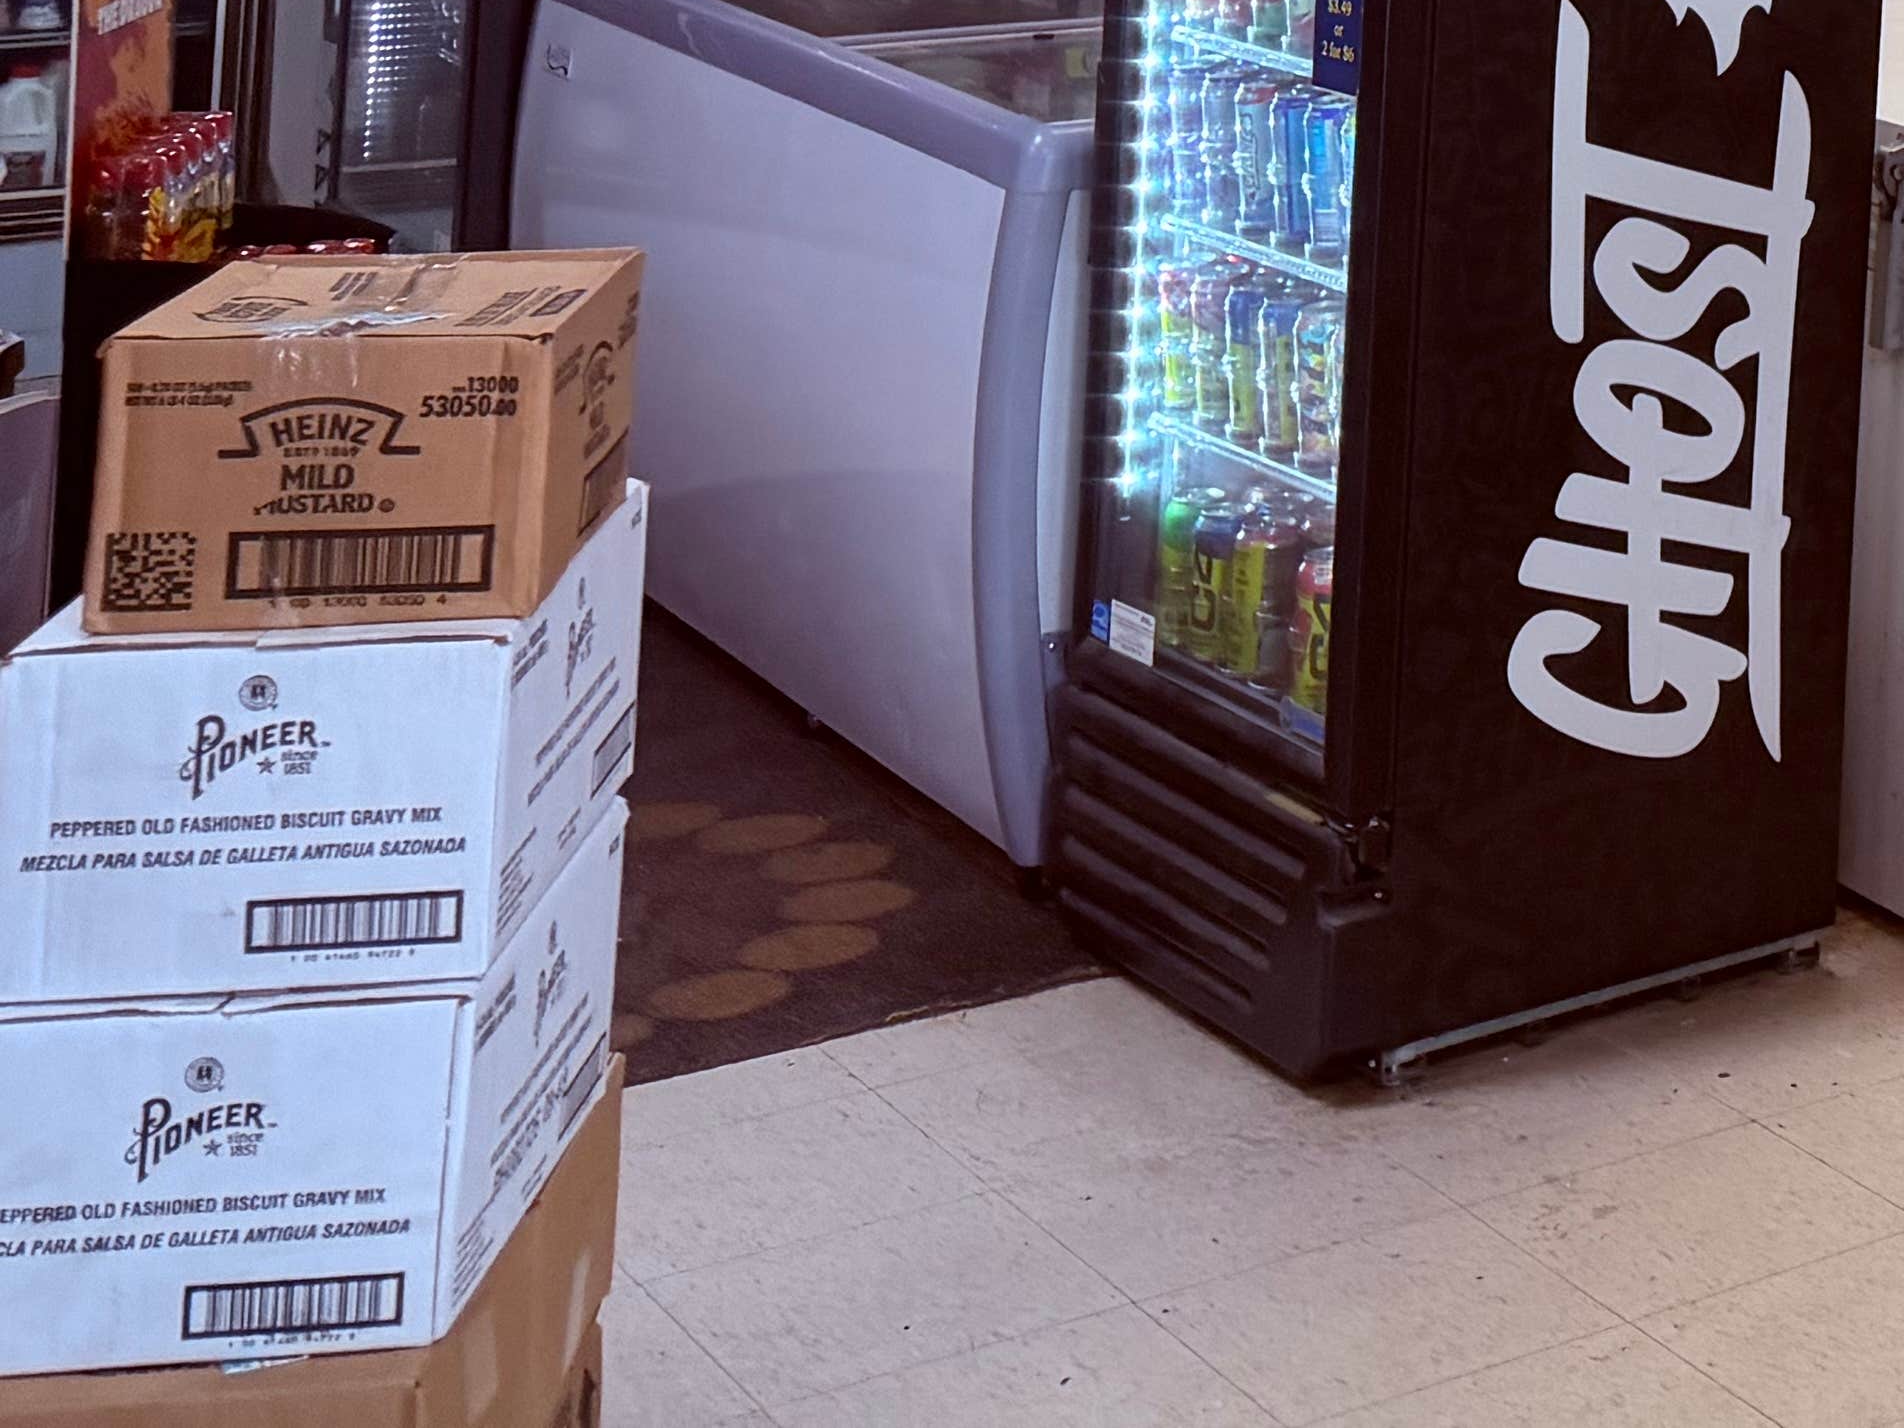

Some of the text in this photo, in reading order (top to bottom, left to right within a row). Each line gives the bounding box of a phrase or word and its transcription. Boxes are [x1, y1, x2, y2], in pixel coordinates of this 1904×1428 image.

[271, 412, 377, 448] HEINZ
[279, 465, 355, 491] MILD
[179, 713, 317, 799] PIONEER
[50, 805, 442, 839] PEPPERED OLD FASHIONED BISCUIT GRAVY MIX
[142, 836, 466, 868] SALSA GALLETA SAZONADA
